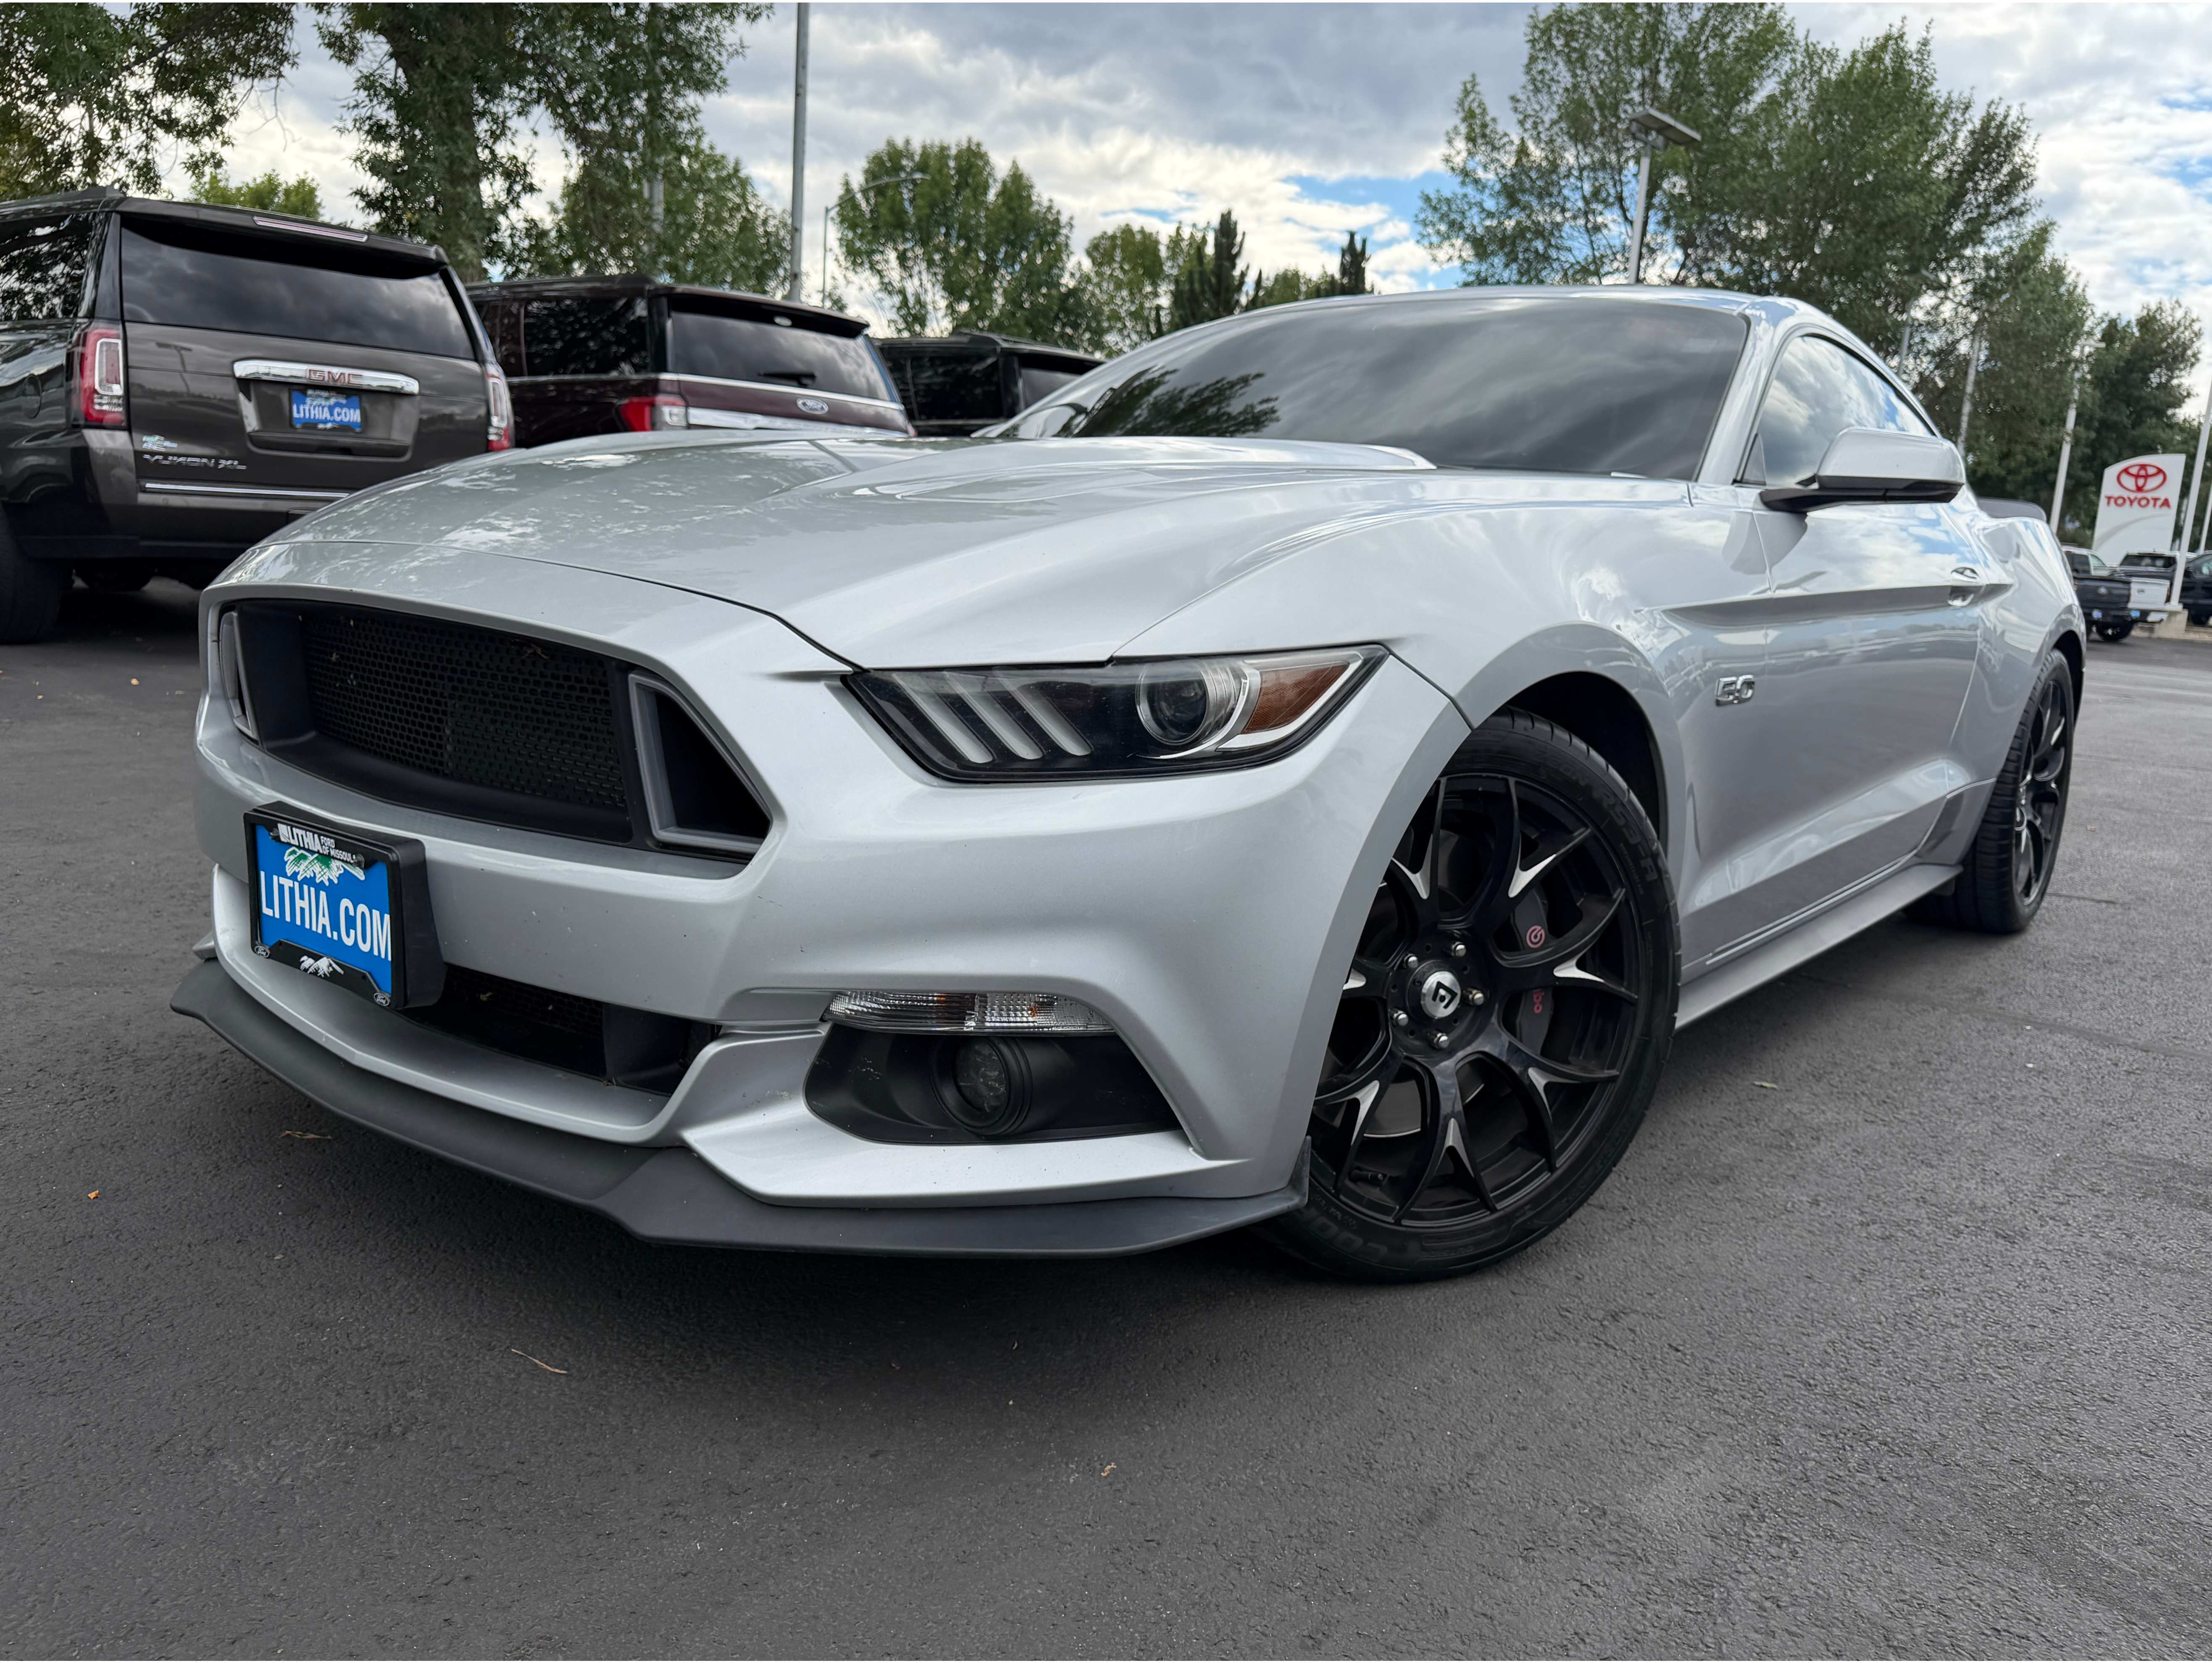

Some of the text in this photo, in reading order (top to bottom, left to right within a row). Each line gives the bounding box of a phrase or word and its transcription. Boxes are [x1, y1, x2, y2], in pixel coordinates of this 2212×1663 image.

[308, 369, 363, 385] GMC
[293, 404, 361, 423] LITHIA.COM
[218, 459, 247, 470] XL
[2105, 496, 2171, 509] TOYOTA
[287, 825, 323, 853] LITHIA
[320, 836, 335, 848] FORD
[322, 845, 329, 855] OF
[260, 871, 391, 961] LITHIA.COM
